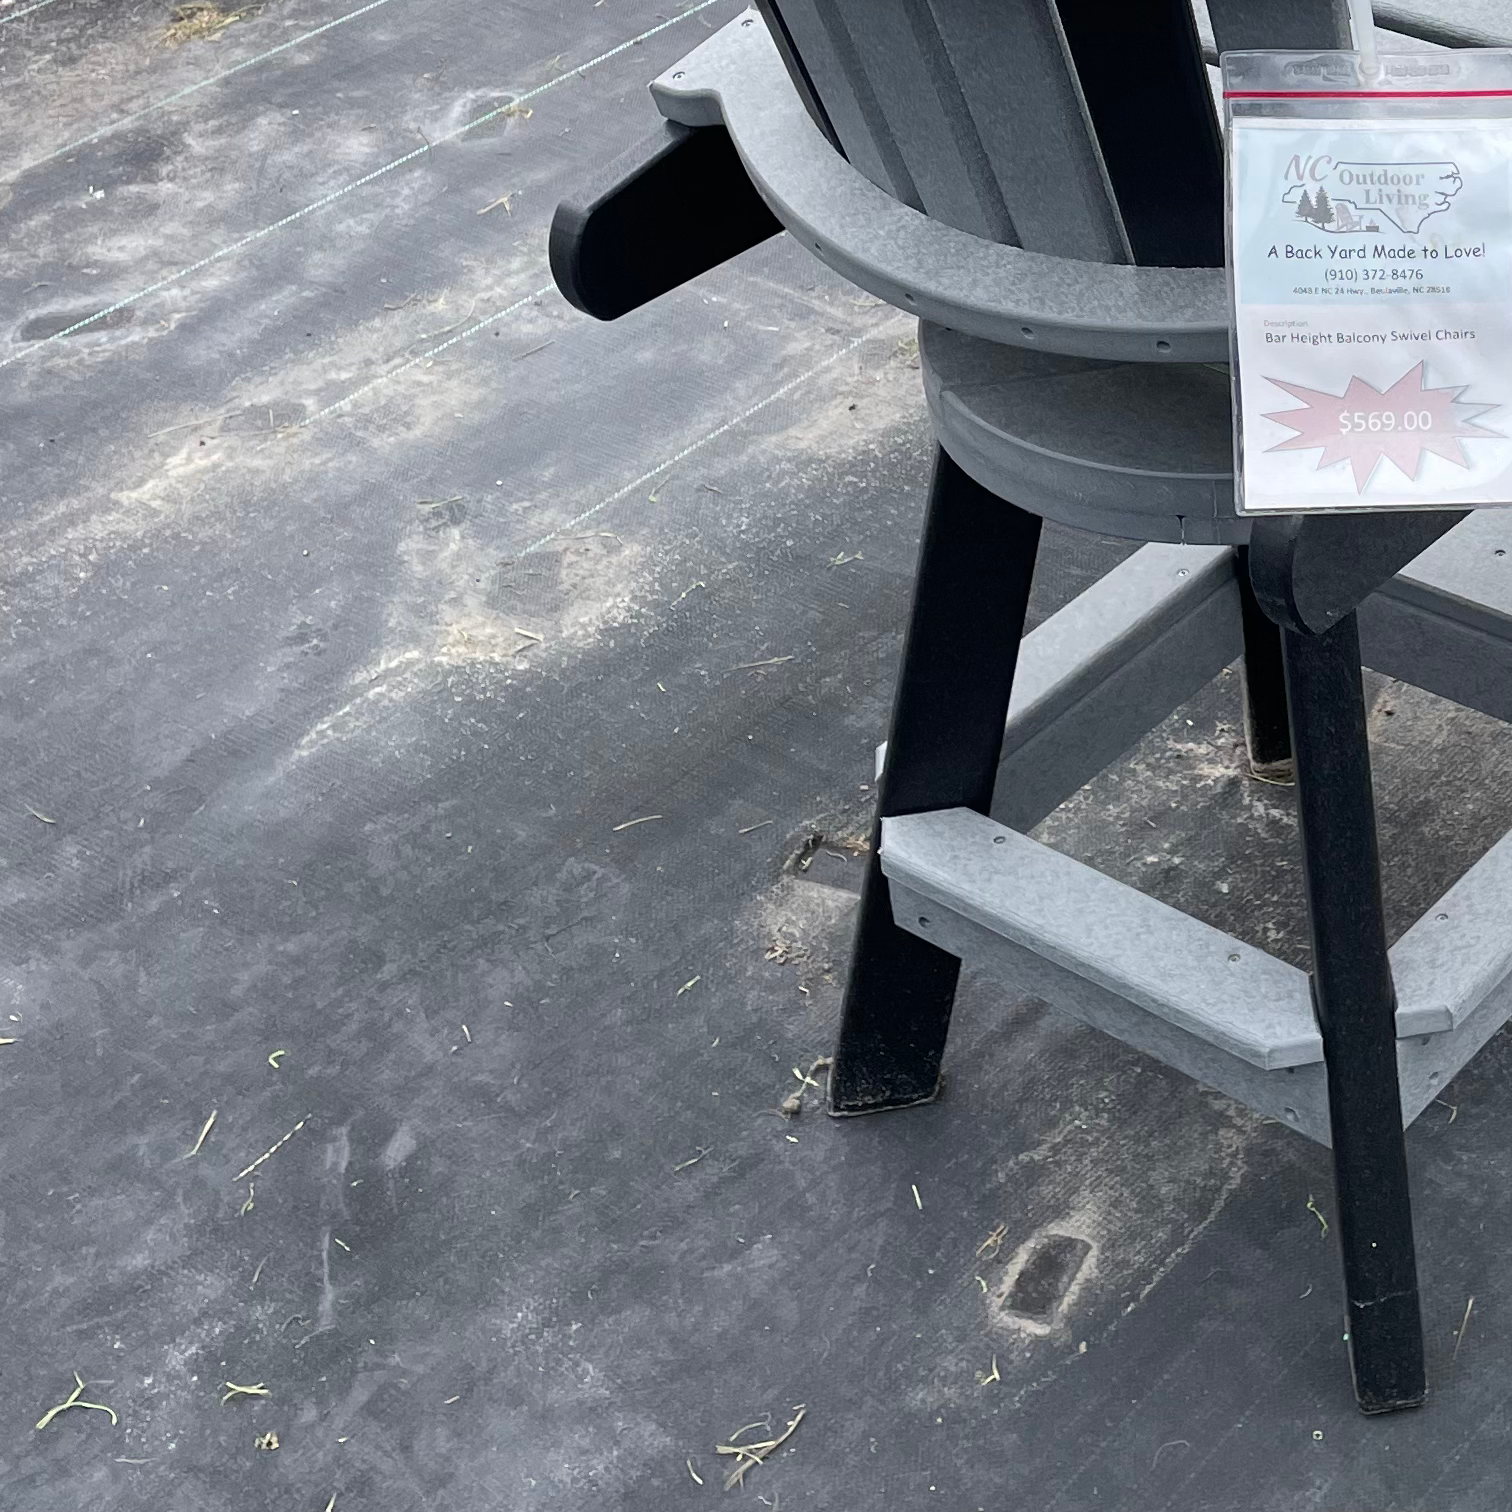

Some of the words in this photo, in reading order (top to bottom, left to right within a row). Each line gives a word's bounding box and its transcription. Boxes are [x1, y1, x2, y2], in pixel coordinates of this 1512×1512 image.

[1284, 154, 1333, 182] NC
[1338, 168, 1425, 186] Outdoor
[1364, 188, 1430, 210] Living
[1267, 245, 1279, 259] A
[1285, 244, 1323, 259] Back
[1327, 244, 1367, 259] Yard
[1372, 244, 1416, 259] Made
[1421, 245, 1439, 259] to
[1444, 243, 1487, 259] Love!
[1324, 268, 1358, 283] (910)
[1362, 268, 1424, 281] 372-8476
[1412, 286, 1425, 294] NC
[1263, 319, 1309, 329] Description
[1265, 332, 1287, 344] Bar
[1291, 331, 1333, 346] Height
[1337, 331, 1387, 345] Balcony
[1390, 329, 1432, 342] Swivel
[1435, 328, 1477, 341] Chairs
[1338, 409, 1433, 435] $569.00
